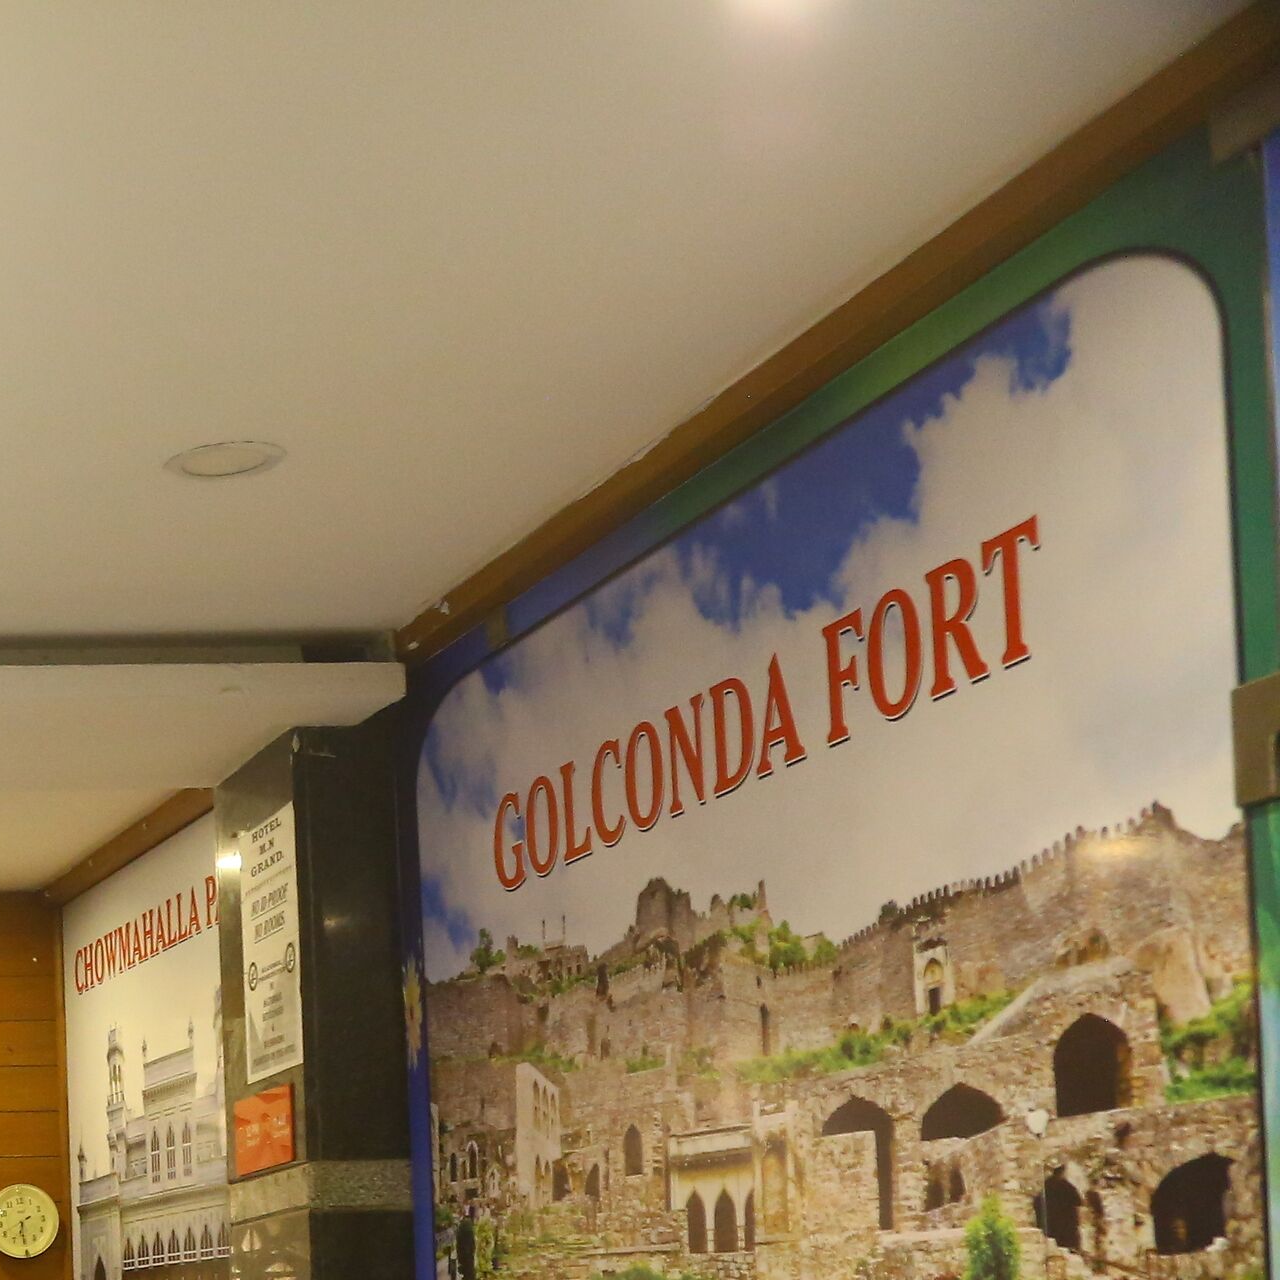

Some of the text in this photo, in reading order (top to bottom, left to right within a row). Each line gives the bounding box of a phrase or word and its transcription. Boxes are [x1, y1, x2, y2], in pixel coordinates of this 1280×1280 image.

[493, 514, 1040, 892] GOLCONDA FORT
[251, 817, 282, 843] HOTEL
[74, 875, 220, 995] CHOWMAHALLA P
